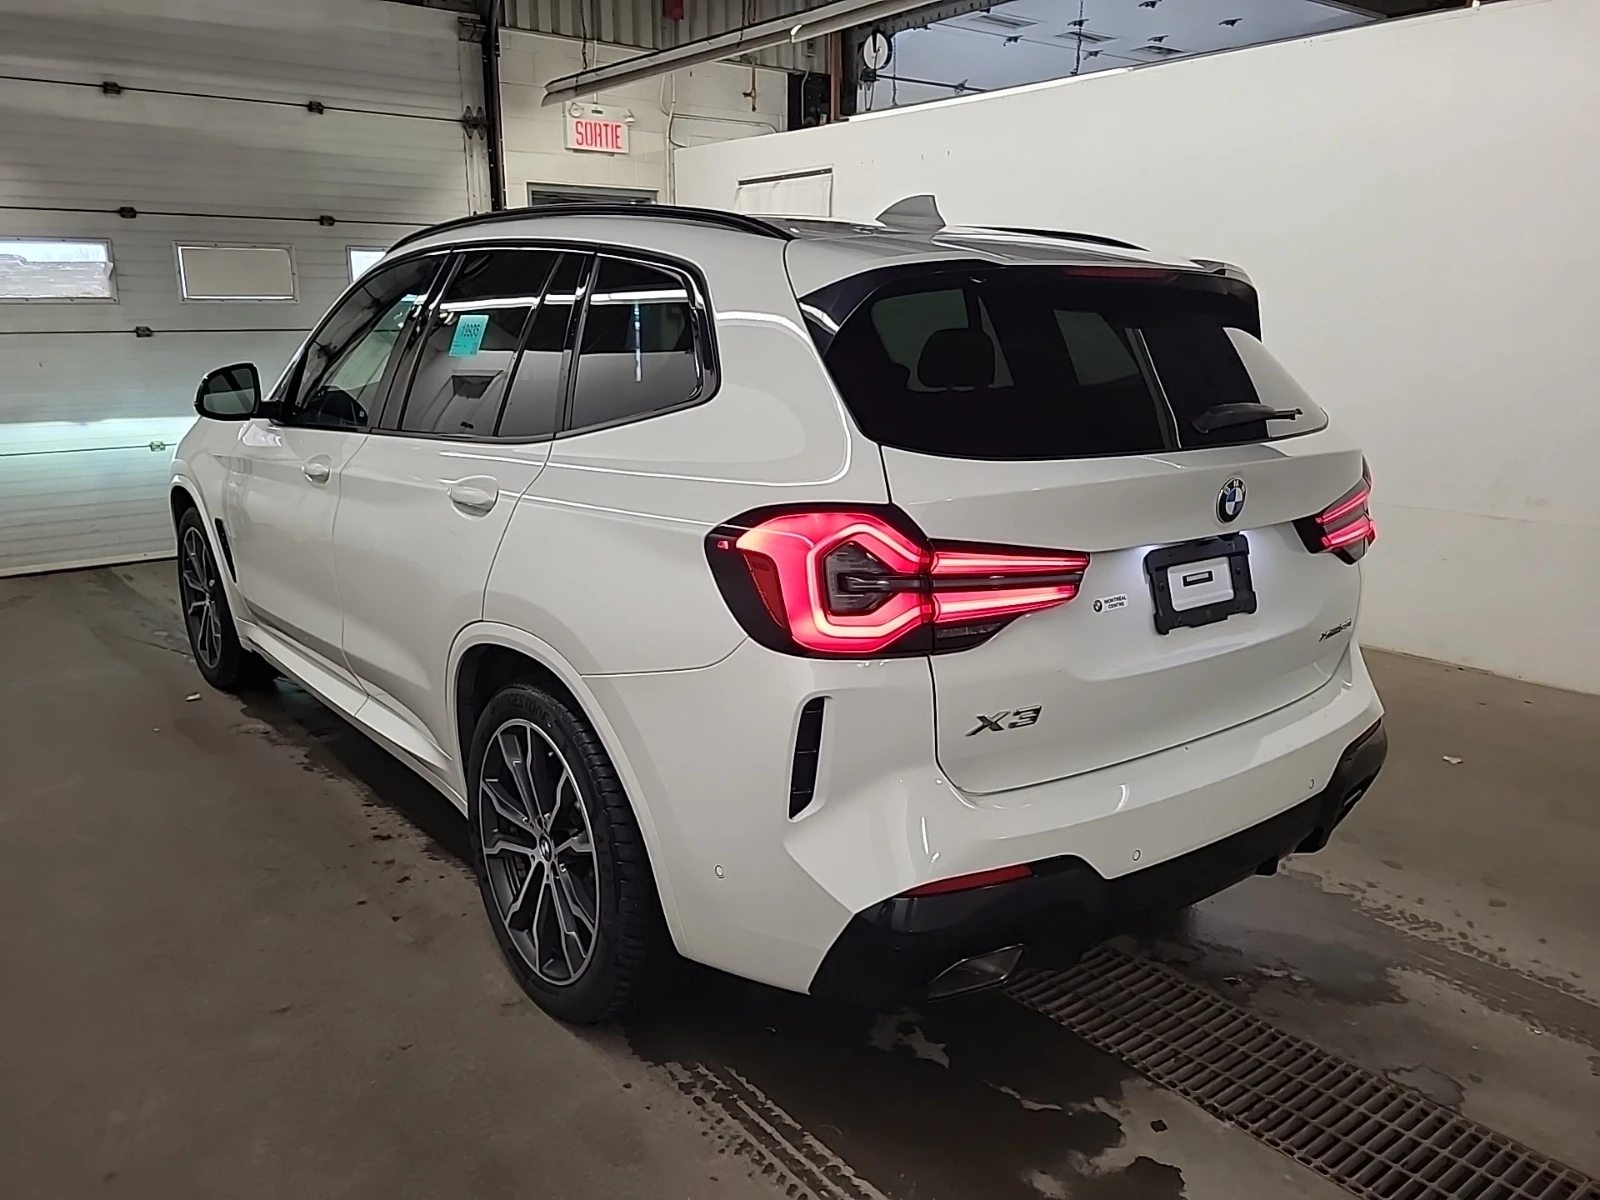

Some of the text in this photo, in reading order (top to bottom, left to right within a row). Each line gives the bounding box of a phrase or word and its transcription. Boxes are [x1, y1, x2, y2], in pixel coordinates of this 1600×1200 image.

[575, 121, 622, 149] SORTIE
[1108, 601, 1125, 609] CENTRE
[965, 704, 1042, 737] X3
